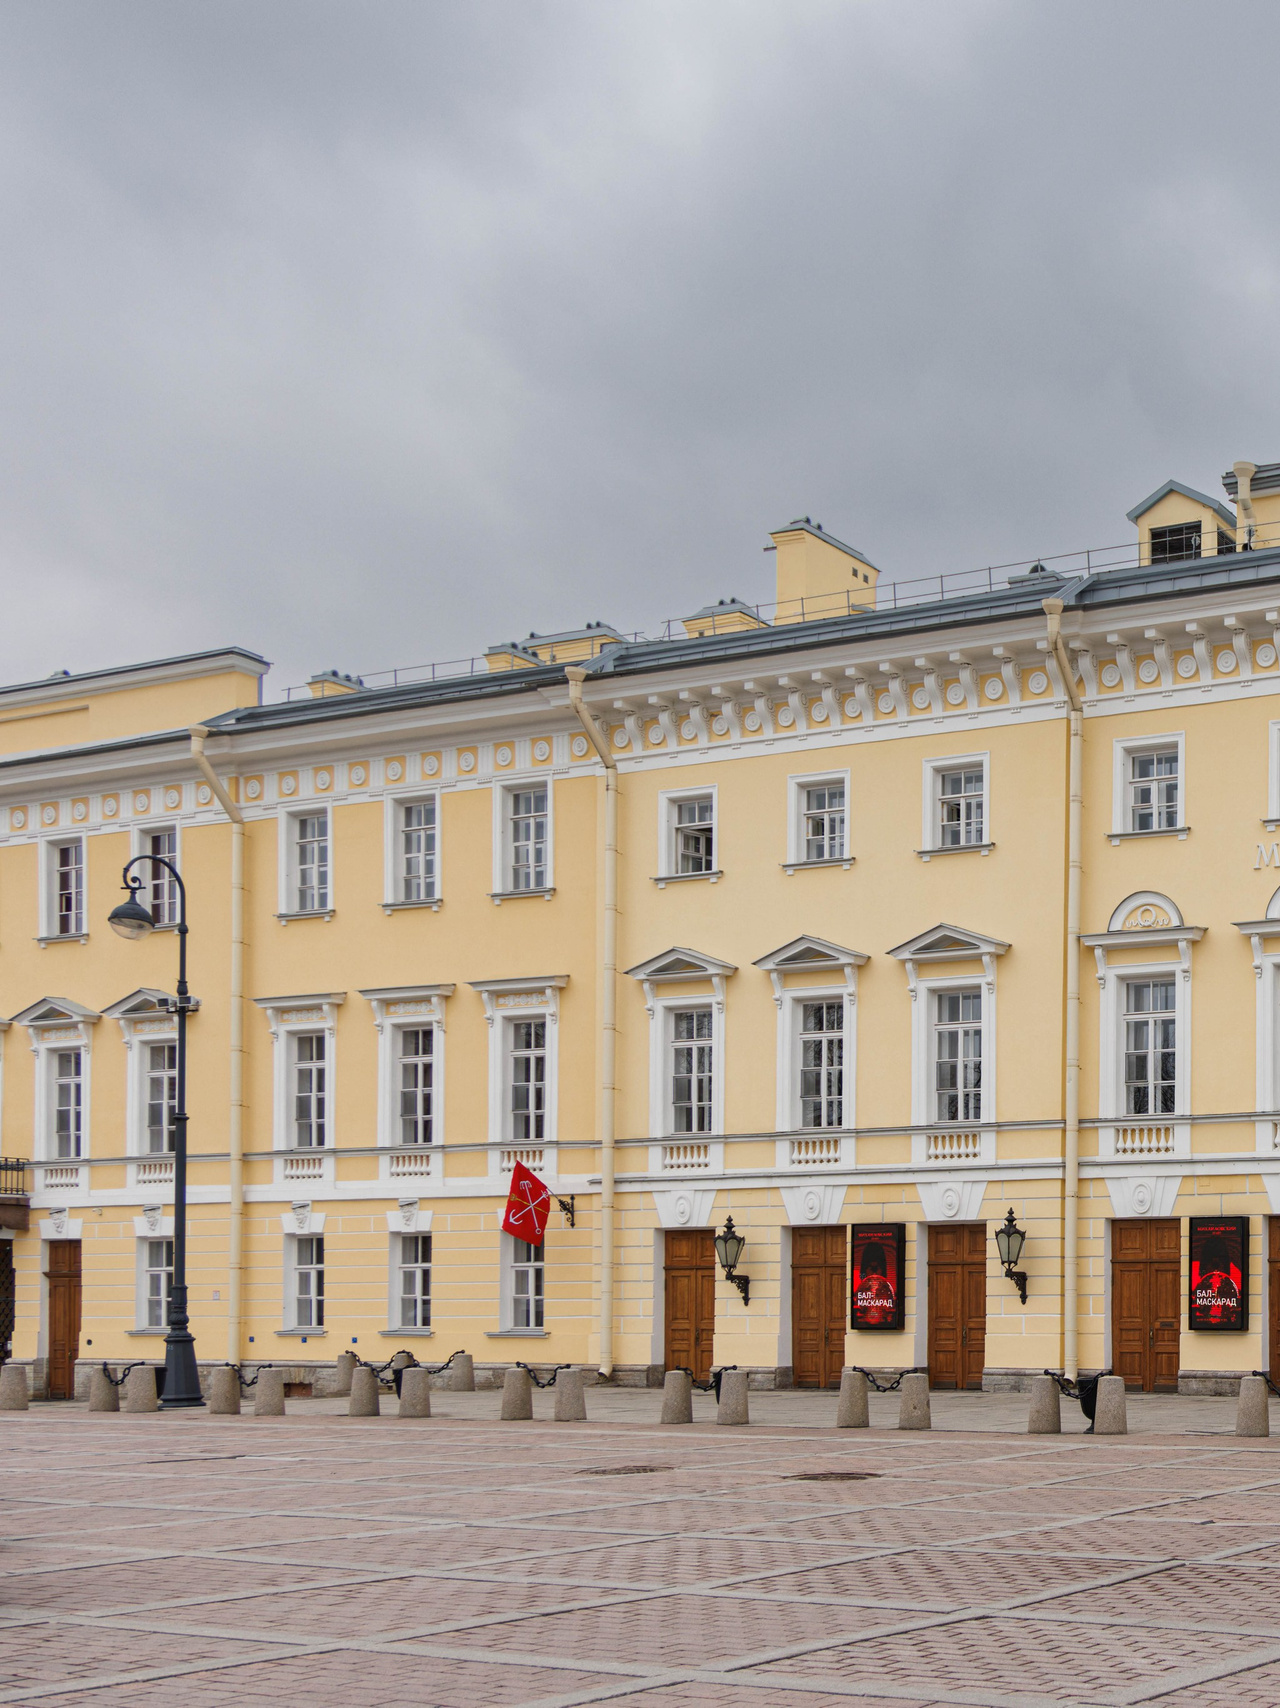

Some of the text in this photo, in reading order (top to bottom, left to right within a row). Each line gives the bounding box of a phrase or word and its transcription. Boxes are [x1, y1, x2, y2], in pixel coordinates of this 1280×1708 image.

[1196, 1290, 1216, 1298] БАЛ-
[857, 1300, 893, 1308] МАСКАРАД
[1196, 1298, 1237, 1307] МАСКАРАД
